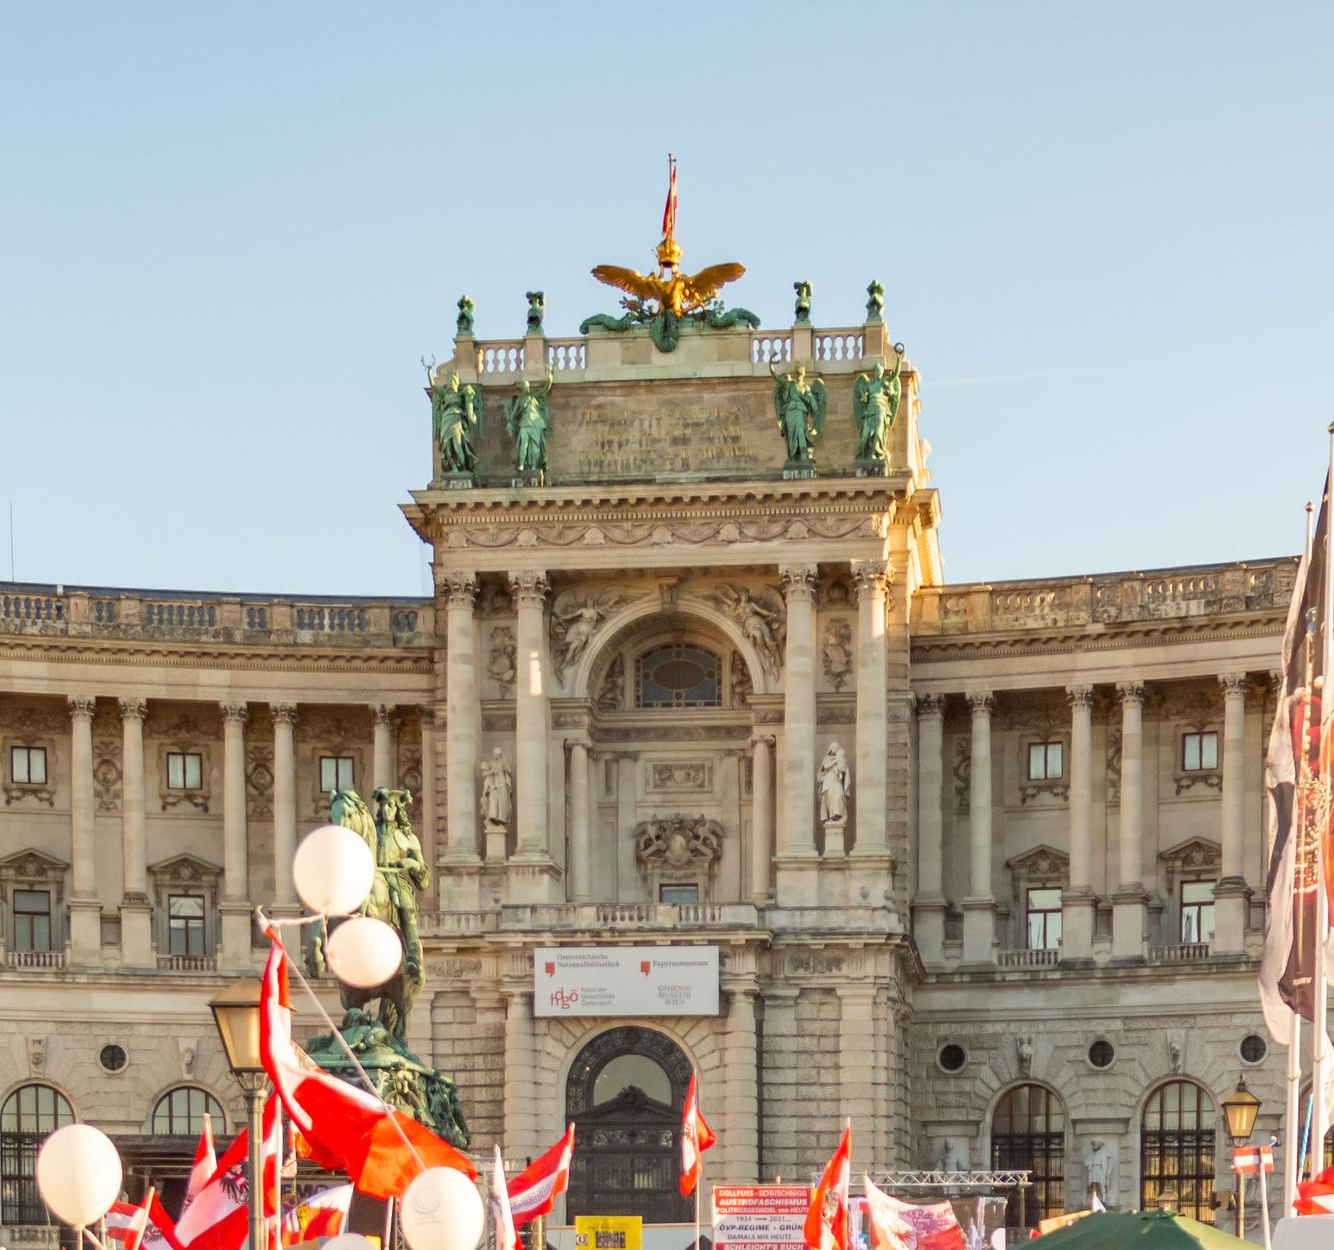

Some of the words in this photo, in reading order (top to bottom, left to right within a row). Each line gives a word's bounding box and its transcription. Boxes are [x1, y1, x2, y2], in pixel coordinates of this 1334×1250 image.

[557, 960, 620, 968] Nationalbibliothek
[653, 960, 709, 968] Papyrusmuseum
[780, 1243, 804, 1250] EUCH
